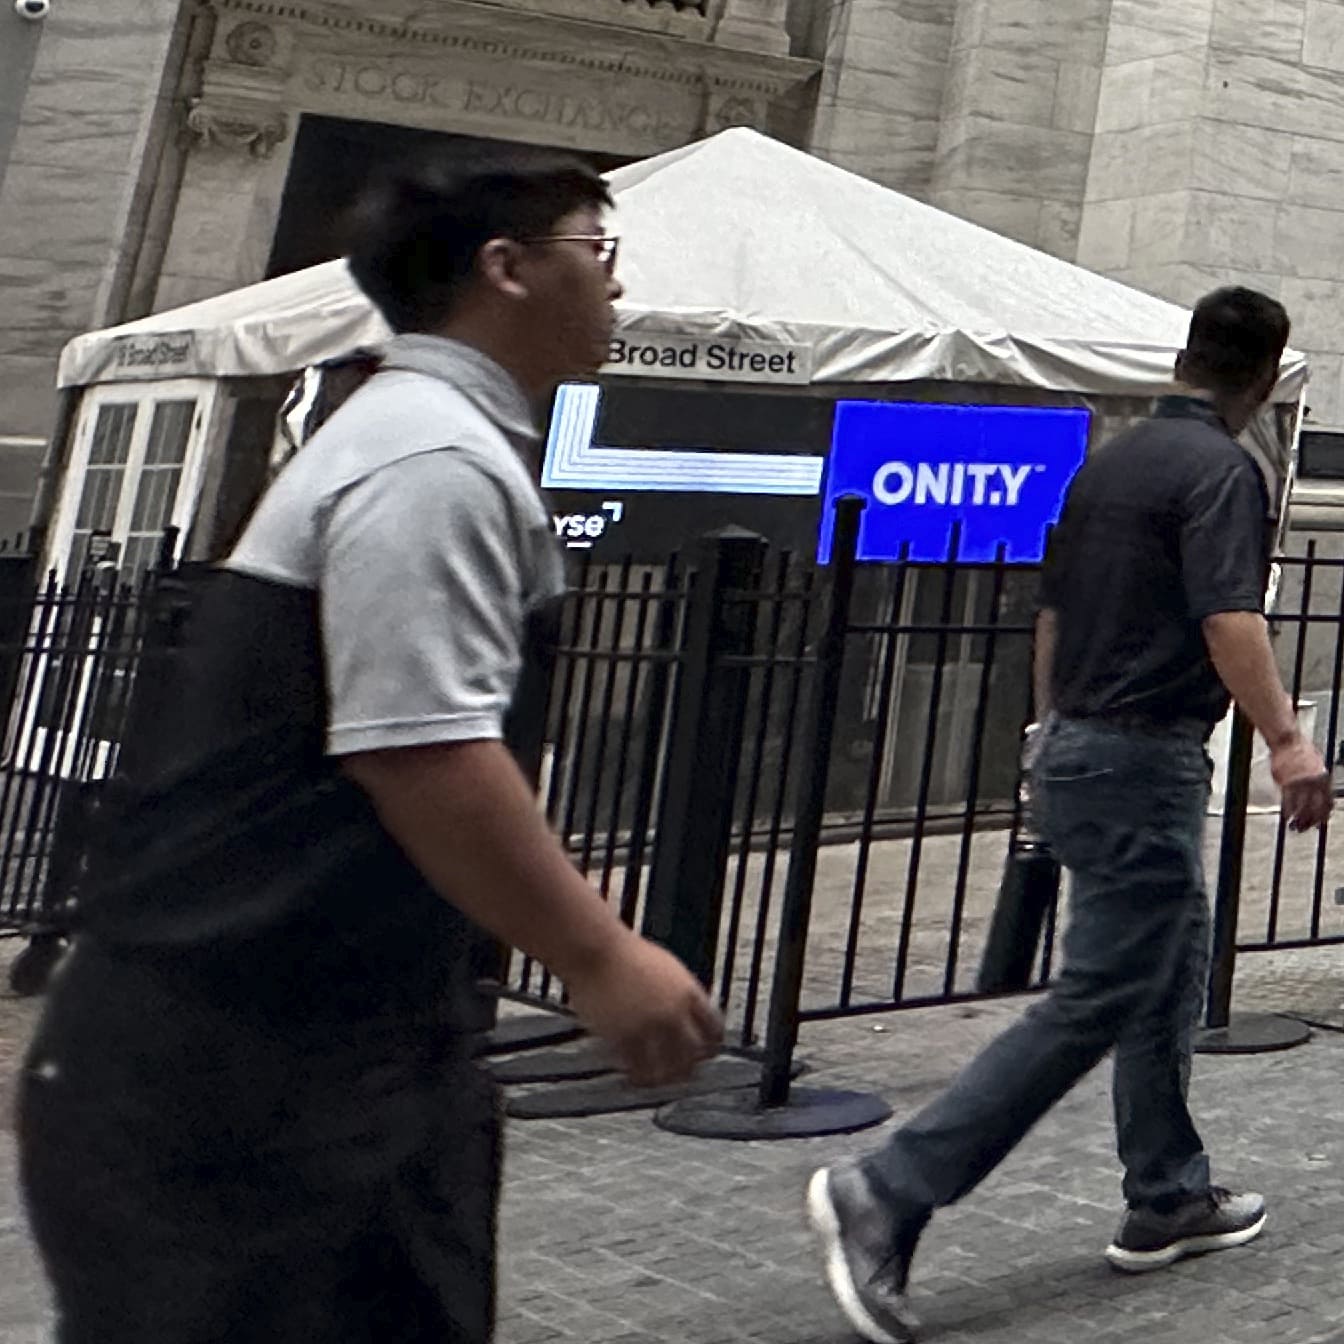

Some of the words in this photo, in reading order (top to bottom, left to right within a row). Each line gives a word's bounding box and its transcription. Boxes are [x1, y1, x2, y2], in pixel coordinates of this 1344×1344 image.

[303, 60, 447, 108] STOCK
[463, 78, 677, 137] EXCHANGE
[609, 339, 698, 369] Broad
[706, 344, 796, 374] Street
[552, 514, 605, 538] yse
